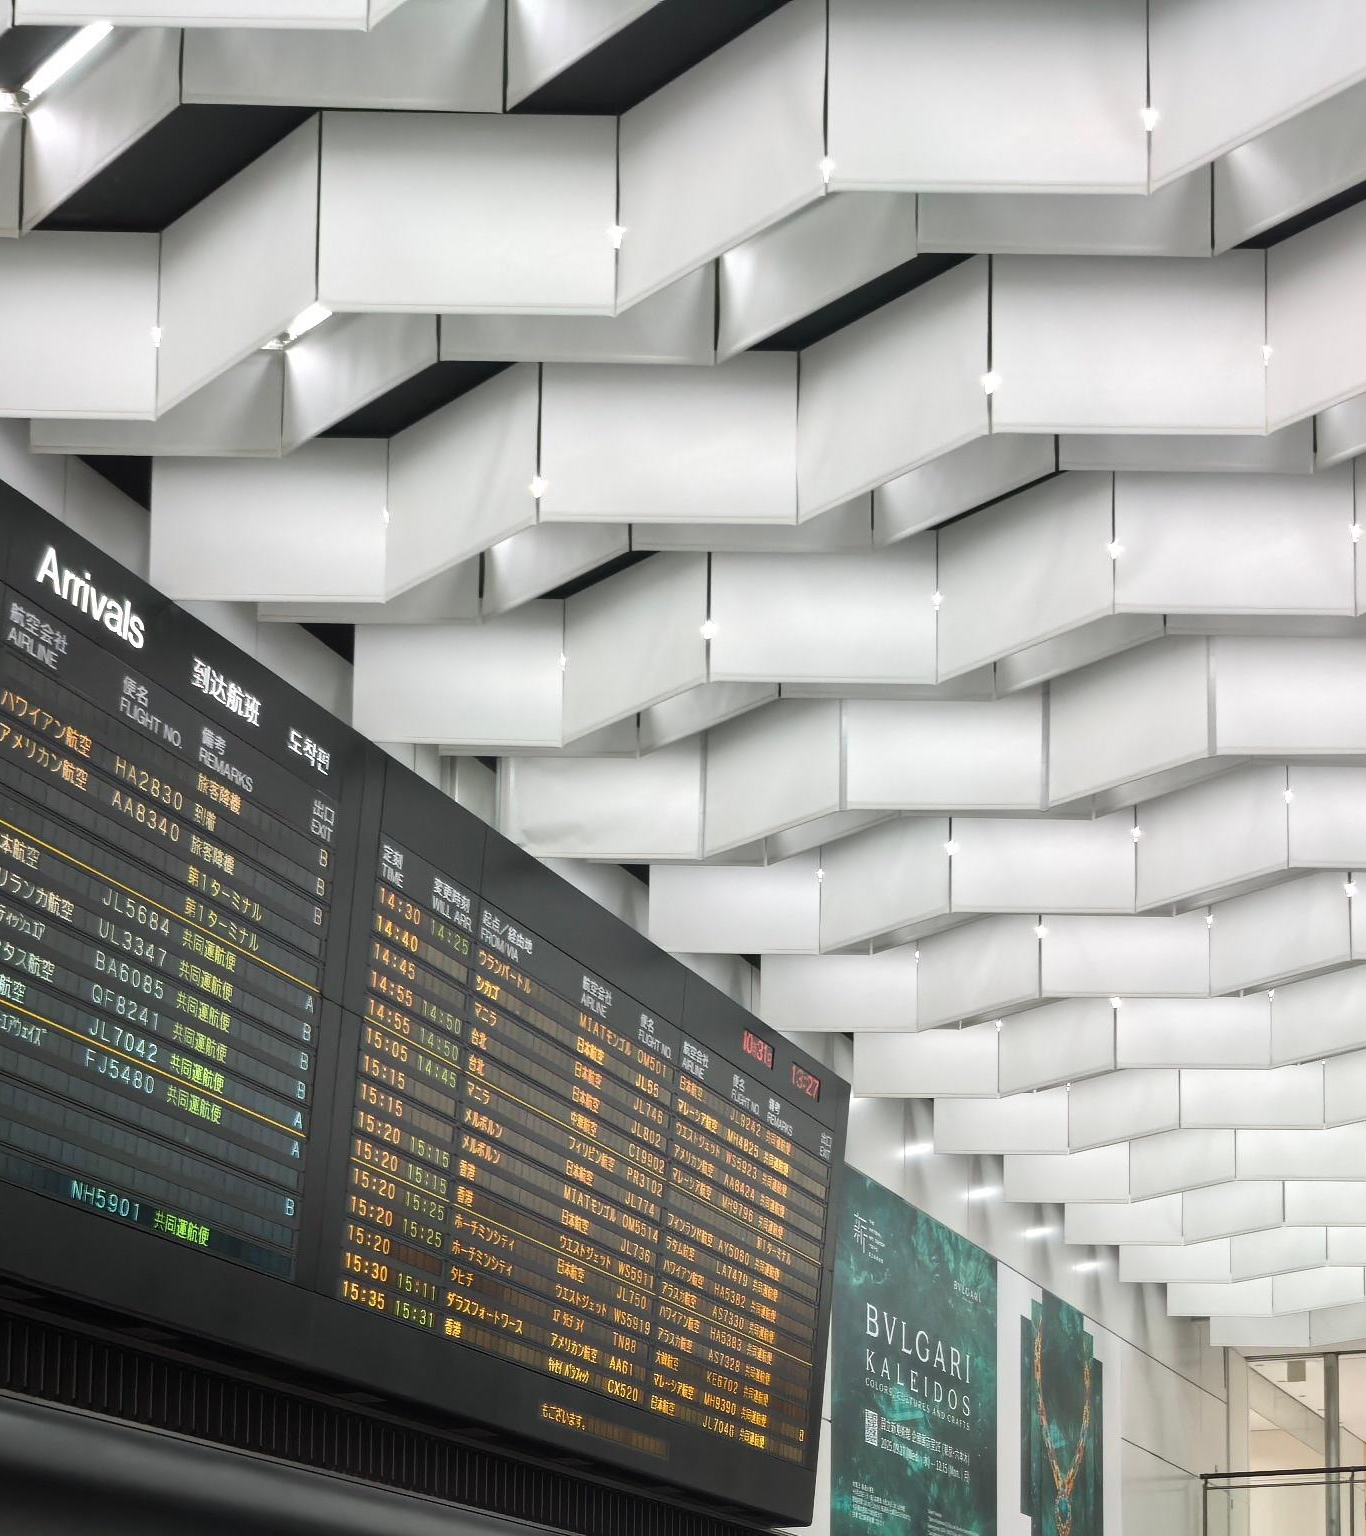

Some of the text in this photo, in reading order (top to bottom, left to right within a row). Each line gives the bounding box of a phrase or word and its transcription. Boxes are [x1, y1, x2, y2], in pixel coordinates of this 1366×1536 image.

[36, 547, 146, 651] Arrivals
[115, 755, 184, 812] HA2830
[198, 748, 254, 793] REMARKS
[112, 791, 180, 842] AA8340
[102, 887, 170, 937] JL5684
[380, 887, 421, 925] 14:30
[377, 914, 419, 953] 14:40
[70, 1179, 140, 1222] NH5901
[345, 1252, 387, 1282] 15:30
[343, 1280, 434, 1328] 15:35 15:31
[865, 1302, 971, 1384] BVLGARI
[865, 1348, 970, 1416] KALEIDOS
[946, 1413, 971, 1431] CRAFTS
